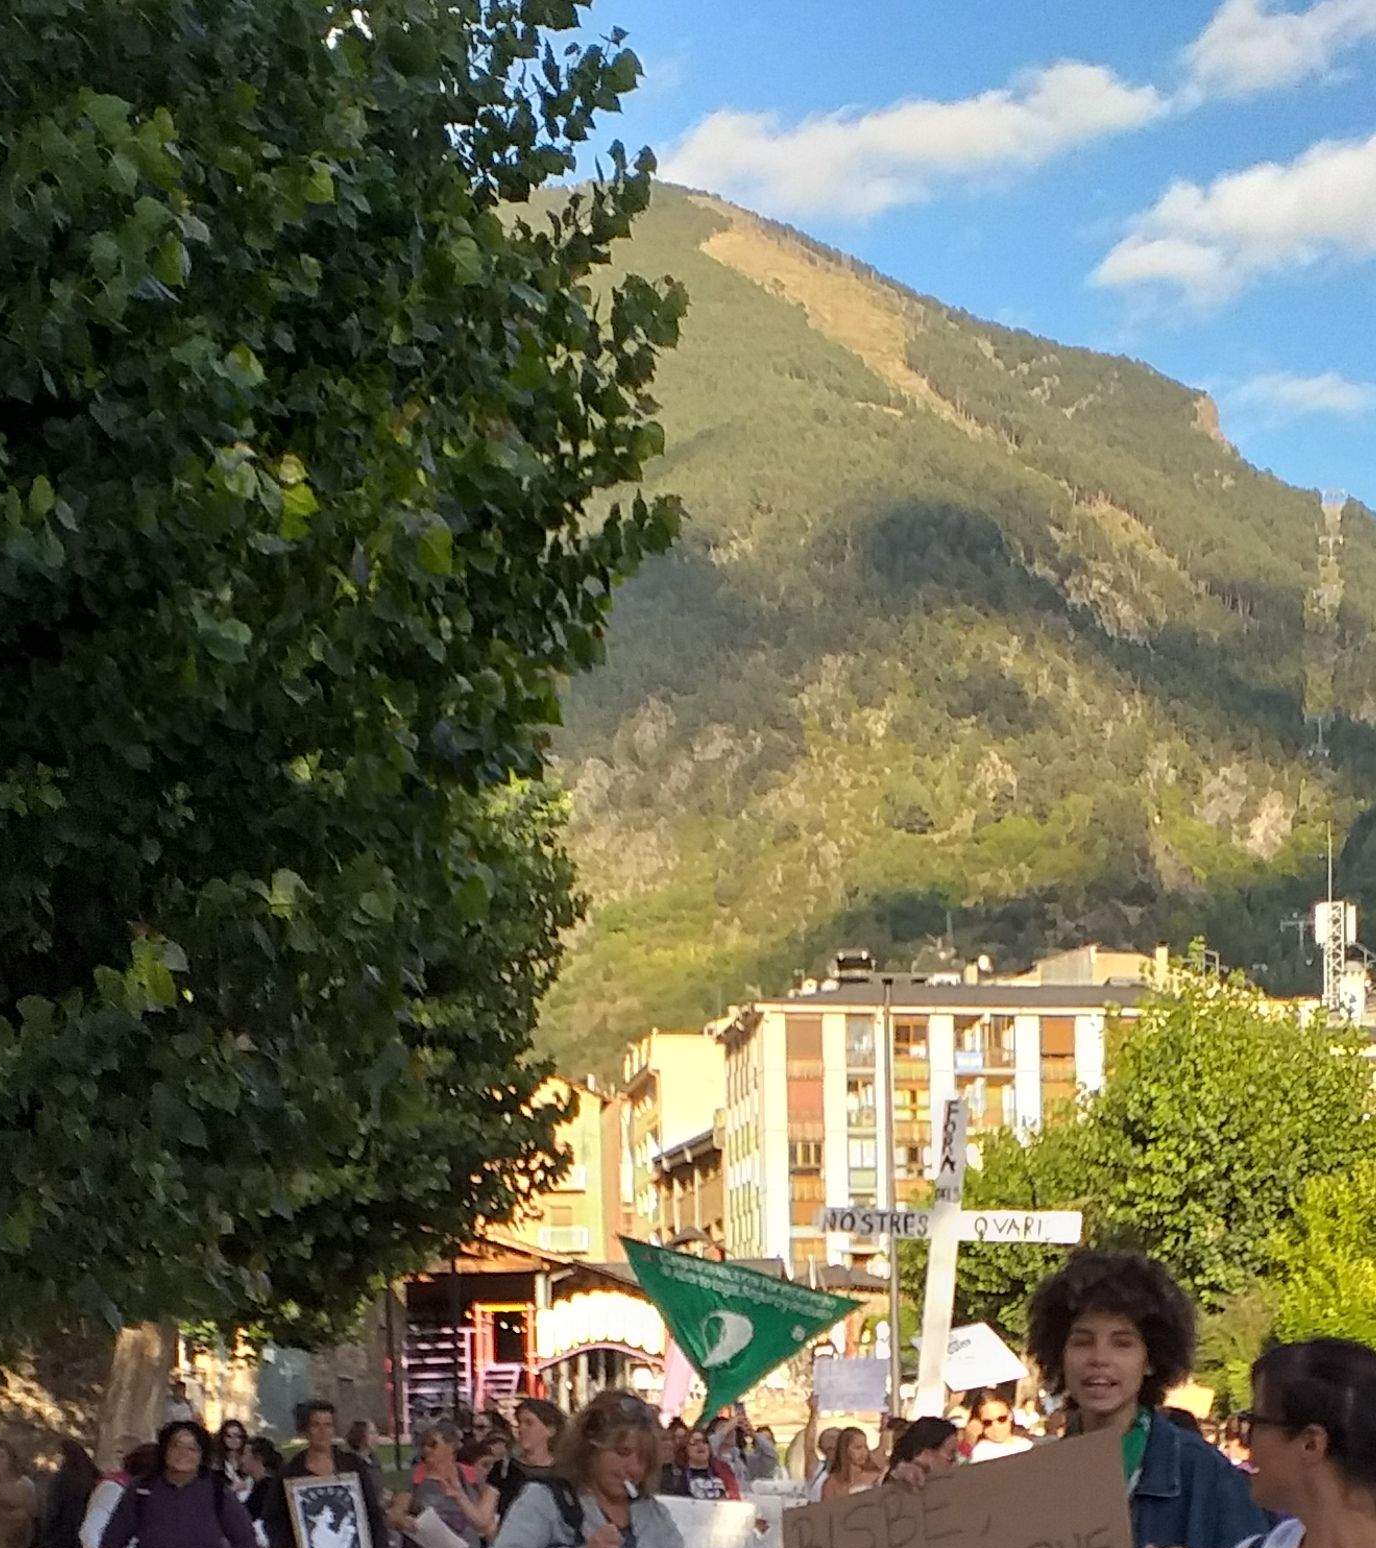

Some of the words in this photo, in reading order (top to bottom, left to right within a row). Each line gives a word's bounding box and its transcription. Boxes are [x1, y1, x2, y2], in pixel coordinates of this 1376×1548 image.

[940, 1100, 960, 1174] FORA
[822, 1211, 929, 1237] NOSTRES
[974, 1216, 1052, 1240] OVARI
